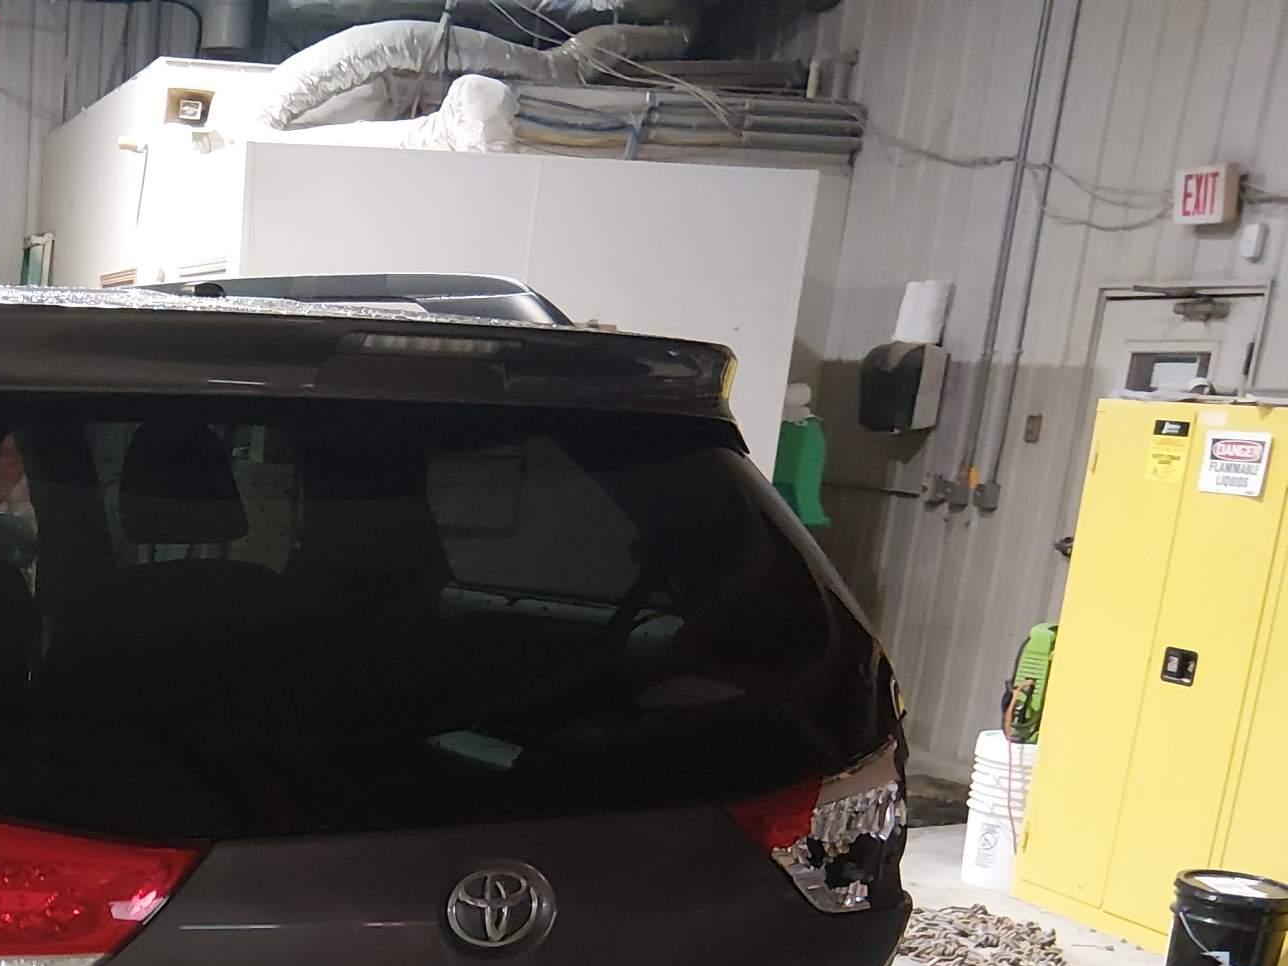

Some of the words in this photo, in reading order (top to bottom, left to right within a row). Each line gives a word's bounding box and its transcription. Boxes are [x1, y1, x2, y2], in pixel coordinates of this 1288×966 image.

[1182, 171, 1220, 216] EXIT
[1214, 442, 1262, 459] DANGER
[1209, 461, 1260, 476] FLAMMABLE
